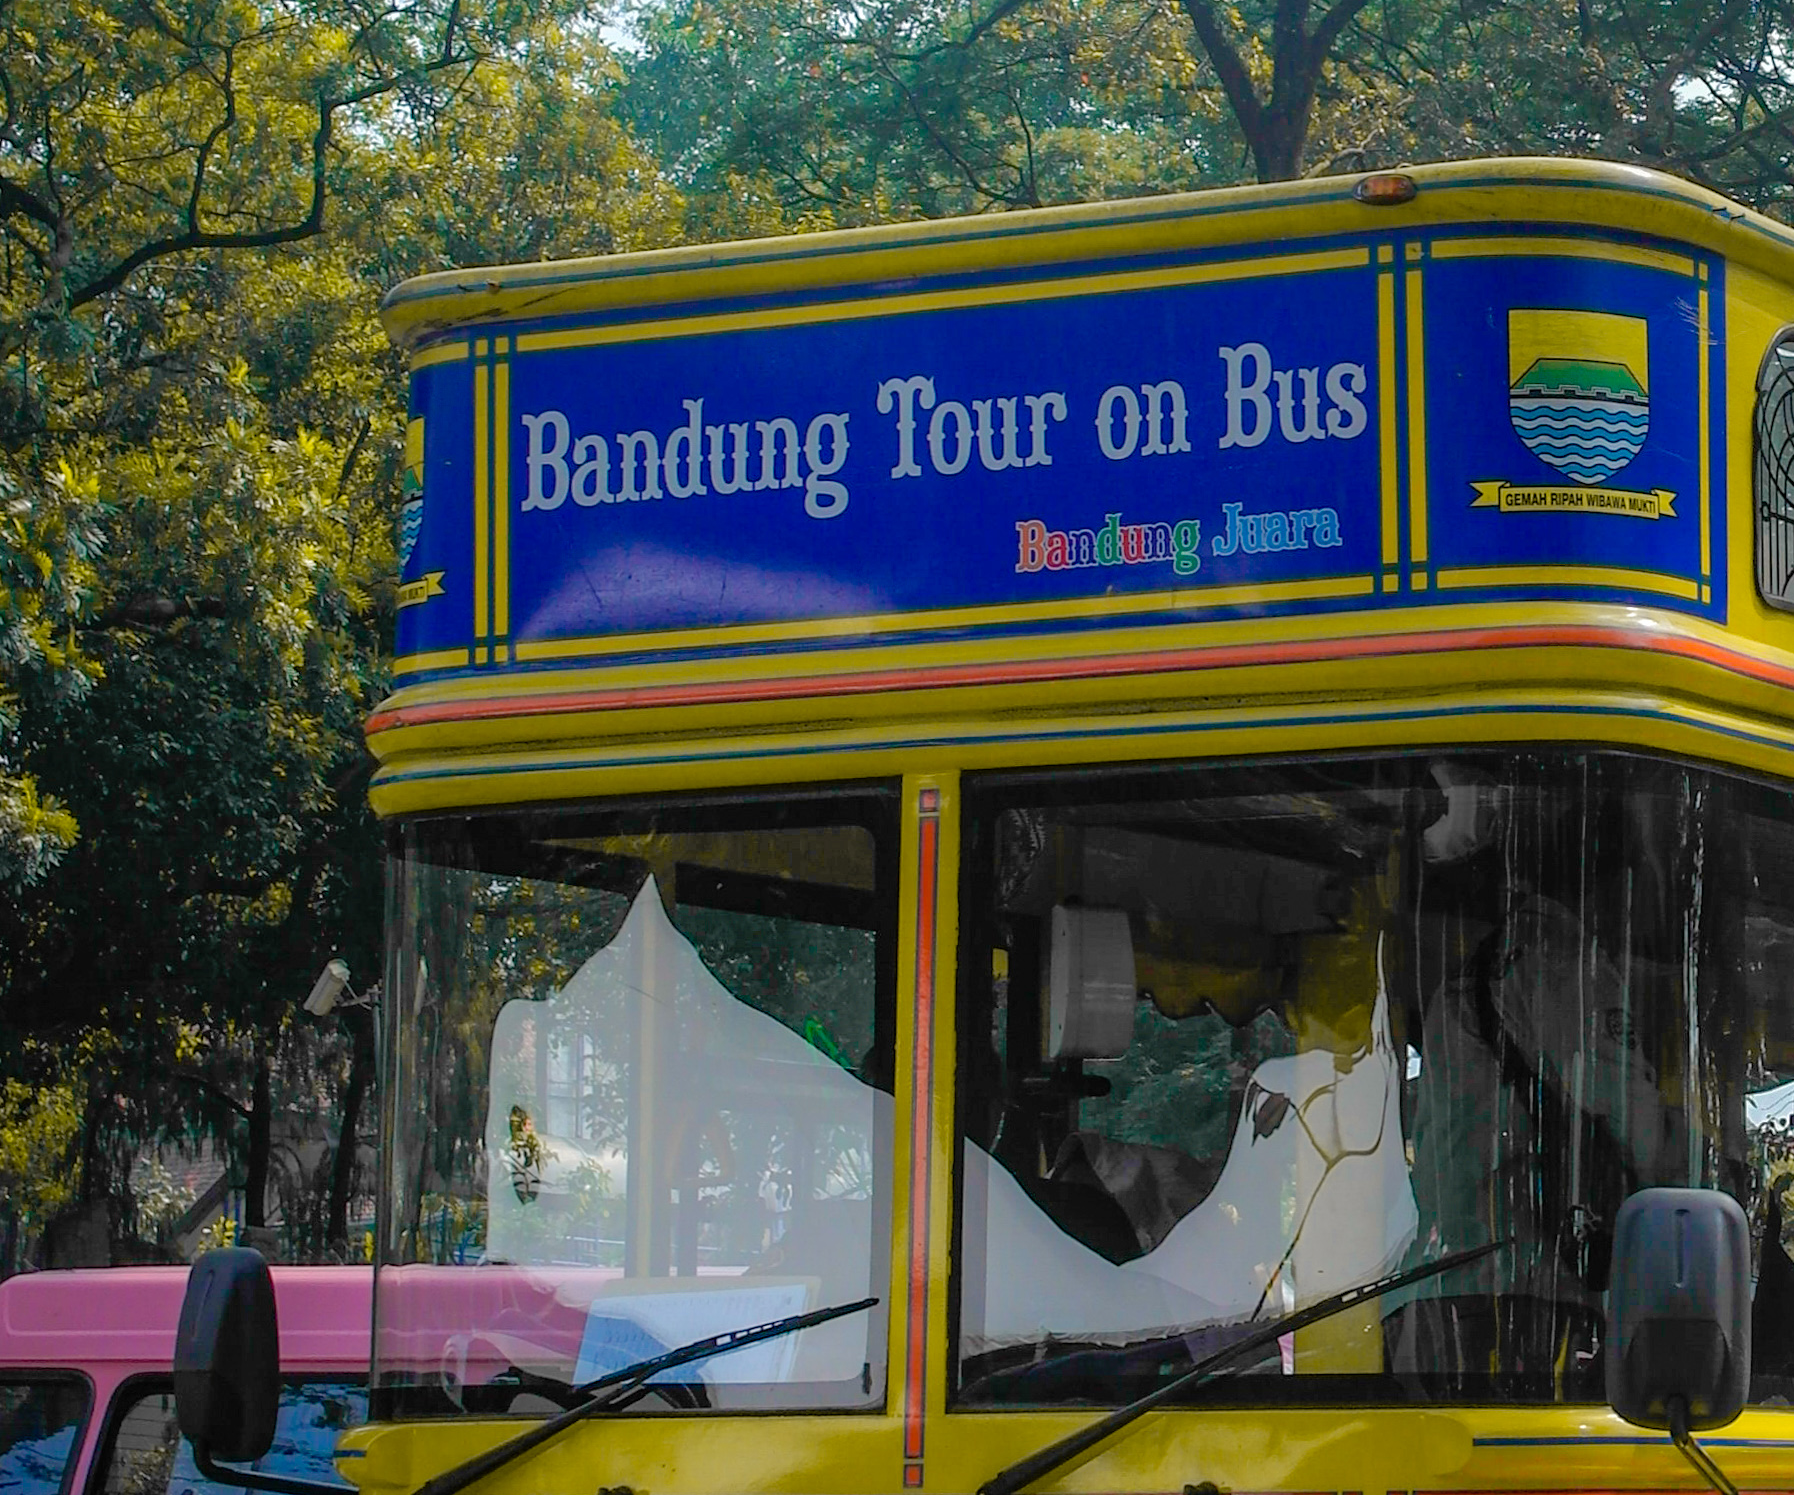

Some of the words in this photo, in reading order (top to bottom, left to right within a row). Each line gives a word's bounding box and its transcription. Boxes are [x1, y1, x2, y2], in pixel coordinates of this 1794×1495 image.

[521, 398, 850, 519] Bandung
[876, 375, 1068, 479] Tour
[1095, 380, 1191, 460] on
[1218, 342, 1367, 449] Bus
[1015, 512, 1200, 575] Bandung
[1213, 501, 1343, 557] Juara
[1505, 492, 1547, 507] GEMAH
[1550, 492, 1583, 507] RIPAH
[1586, 493, 1627, 510] WIBAWA
[1628, 497, 1656, 515] MUKTI
